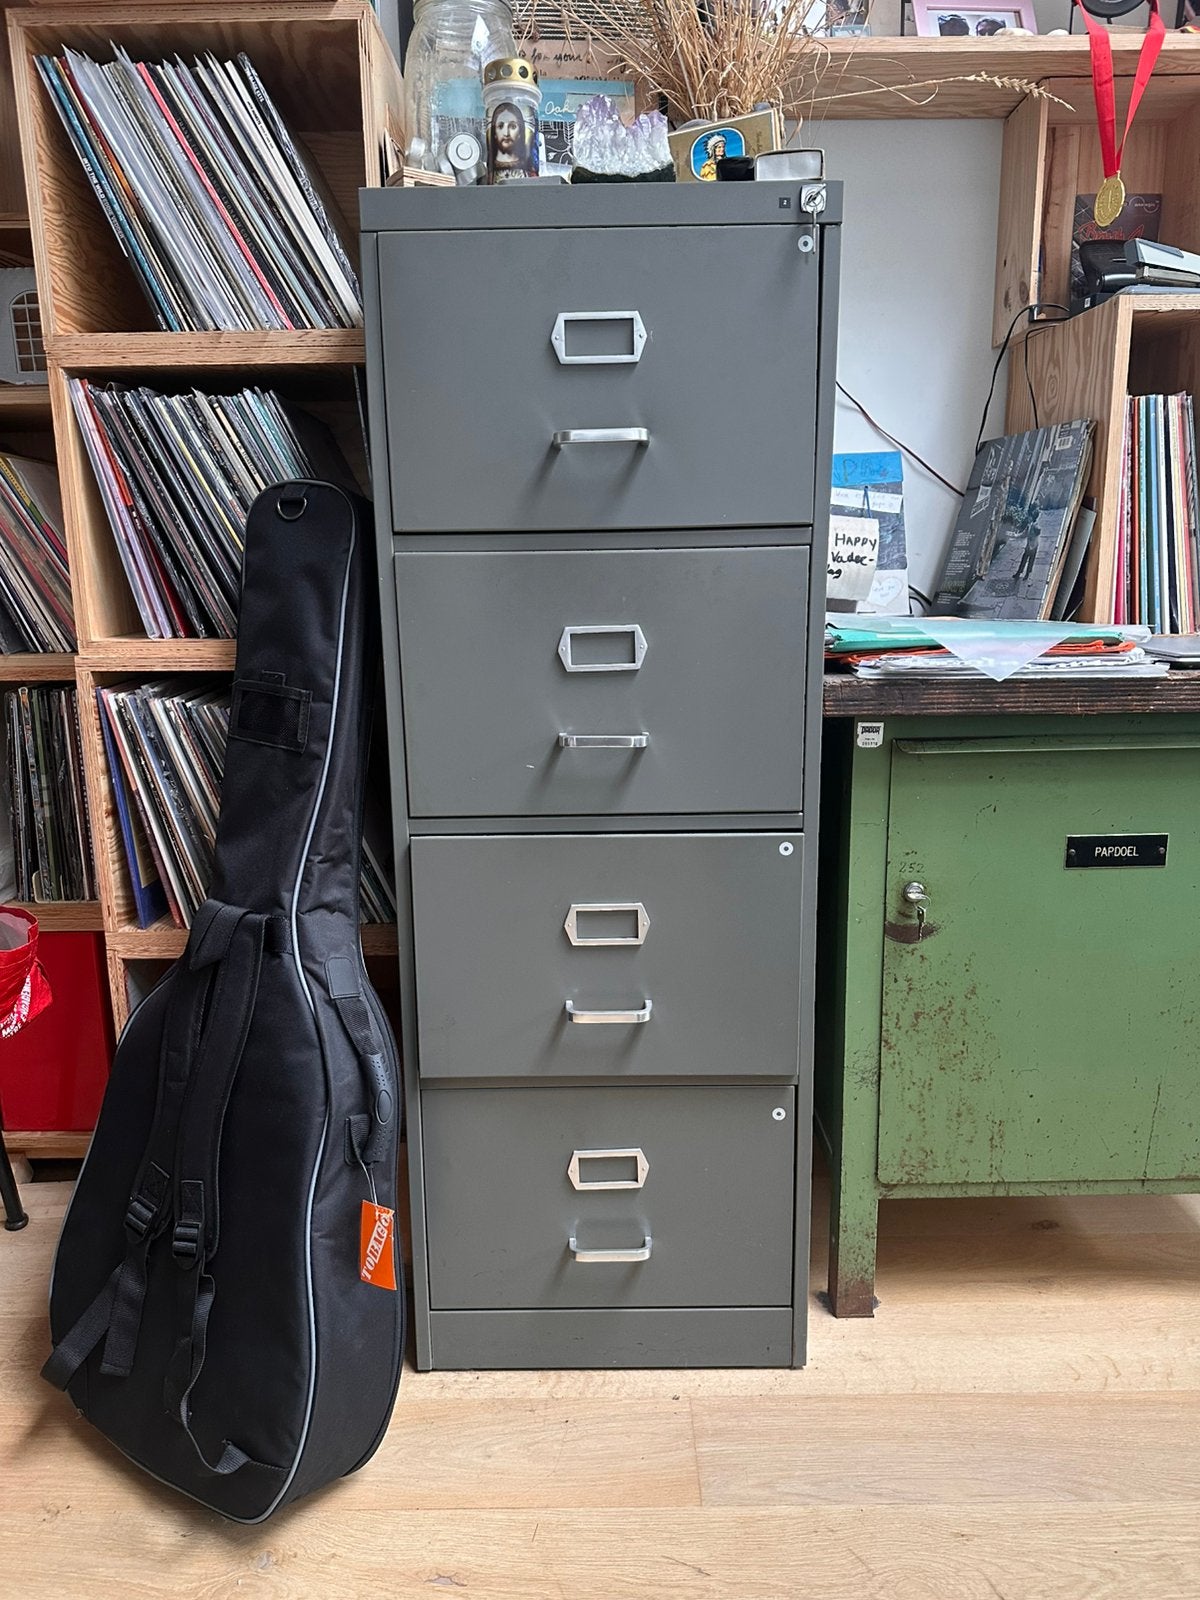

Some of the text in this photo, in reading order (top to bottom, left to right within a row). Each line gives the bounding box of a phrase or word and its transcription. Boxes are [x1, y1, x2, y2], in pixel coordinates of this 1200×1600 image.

[81, 156, 92, 172] INTO
[89, 171, 98, 184] THE
[94, 183, 105, 198] WILD
[834, 533, 877, 551] HAPPY
[1094, 846, 1139, 857] PAPDOEL
[898, 861, 926, 874] 252
[361, 1214, 391, 1280] TOBAGO
